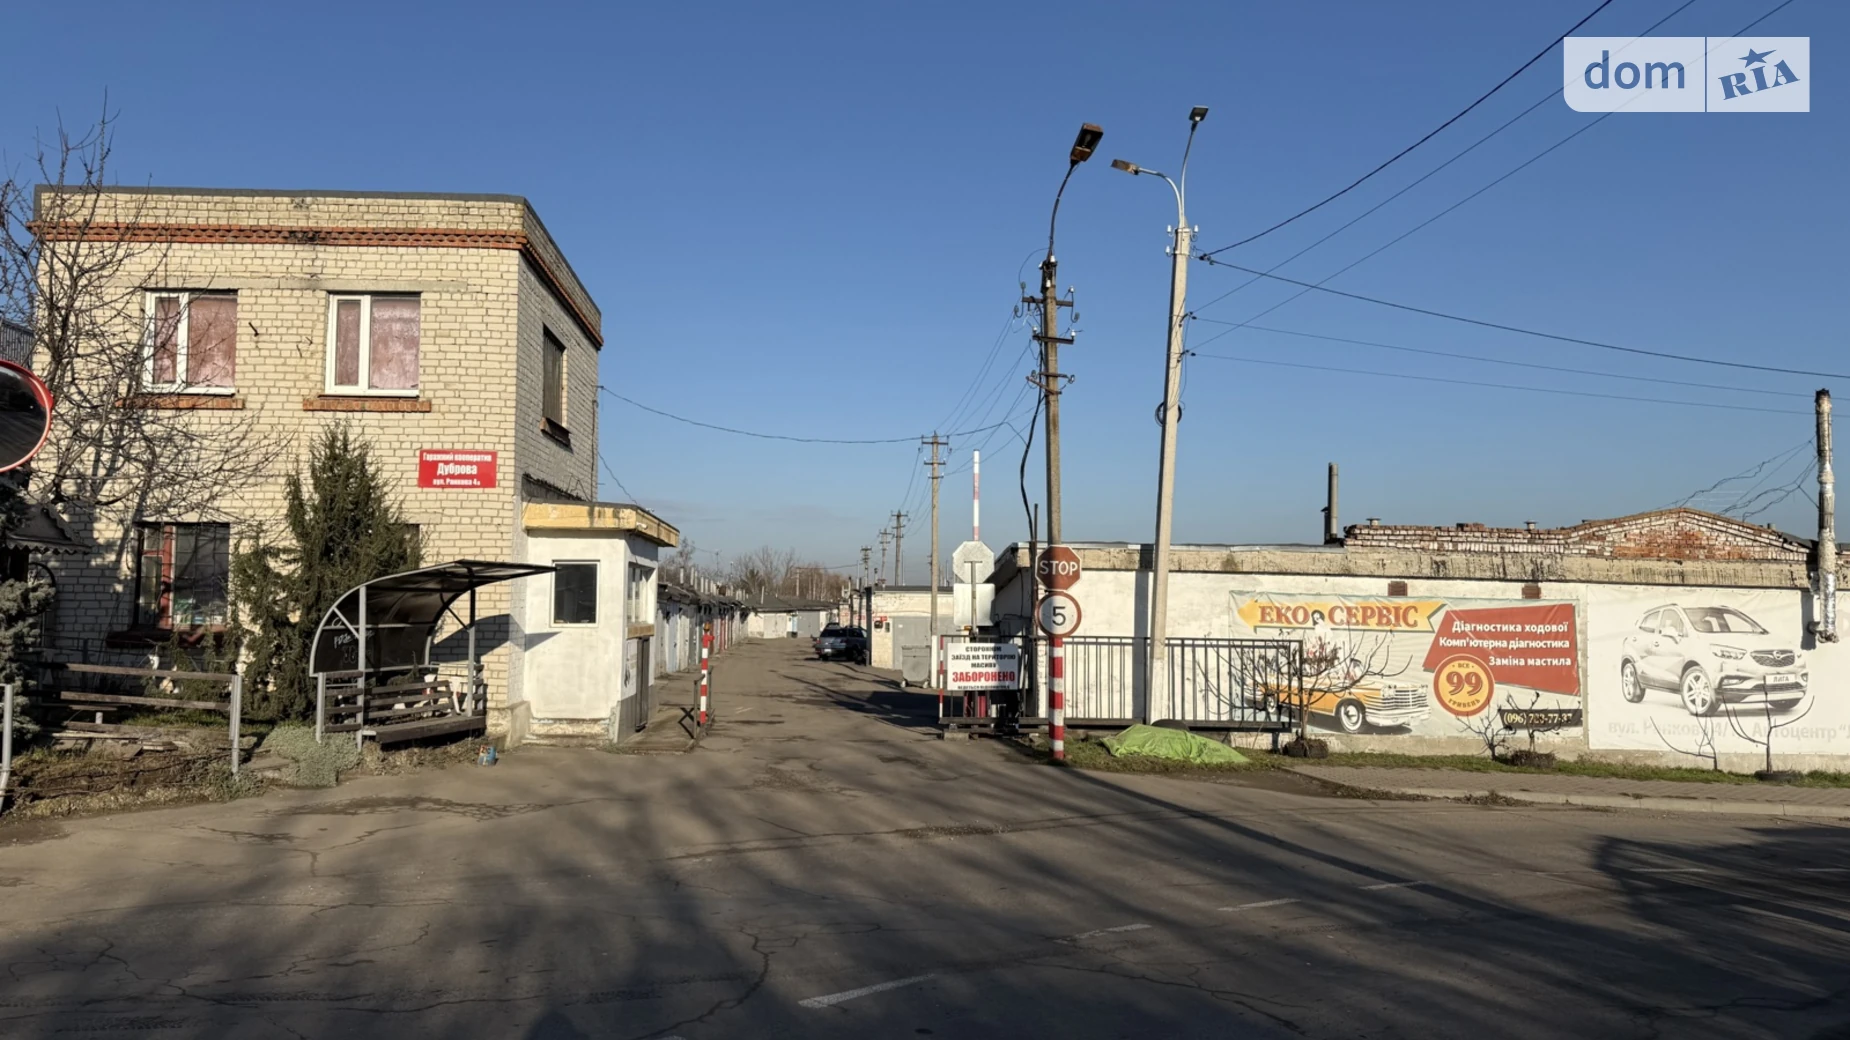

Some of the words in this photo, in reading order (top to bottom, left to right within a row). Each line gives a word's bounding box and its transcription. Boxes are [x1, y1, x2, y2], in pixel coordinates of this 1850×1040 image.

[437, 462, 478, 476] Дуброва
[1039, 560, 1078, 576] STOP
[1052, 606, 1066, 626] 5
[1259, 605, 1310, 625] ЕКО
[1328, 605, 1418, 628] СЕРВІС
[1452, 621, 1522, 634] Діагностика
[1524, 621, 1568, 634] ходової
[1439, 637, 1508, 650] Комп'ютерна
[1508, 638, 1570, 651] діагностика
[1489, 656, 1521, 667] Заміна
[1523, 657, 1571, 667] мастила
[952, 671, 1015, 682] ЗАБОРОНЕНО
[1446, 671, 1483, 697] 99
[1448, 698, 1481, 708] ГРИВЕНЬ
[1503, 712, 1527, 725] (096)
[1608, 721, 1639, 734] вул.
